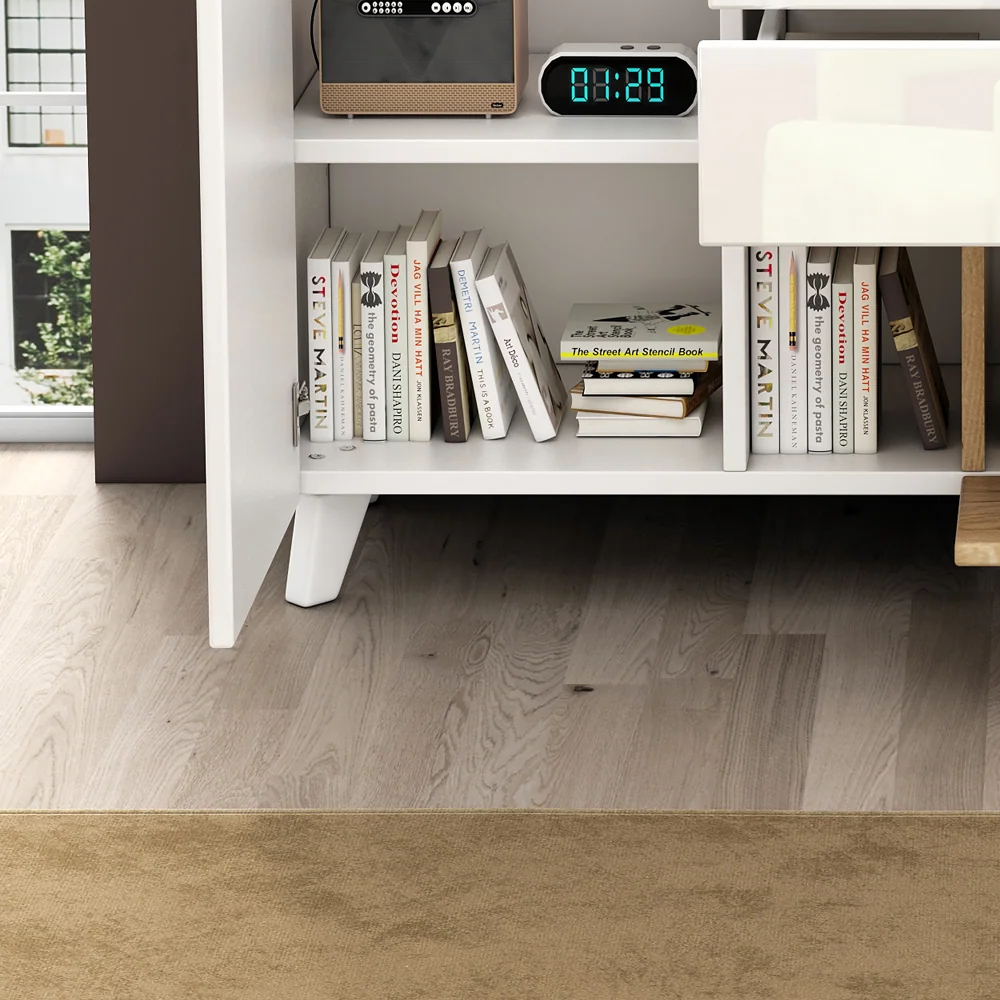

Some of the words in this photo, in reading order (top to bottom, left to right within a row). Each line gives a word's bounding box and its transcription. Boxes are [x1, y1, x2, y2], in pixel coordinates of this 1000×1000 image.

[571, 68, 664, 102] 01:29
[413, 260, 422, 280] JAG
[390, 264, 401, 344] Devotion
[414, 283, 422, 306] VILL
[756, 251, 773, 329] STEVE
[861, 281, 870, 300] JAG
[311, 276, 326, 340] STEVE
[368, 312, 376, 329] the
[414, 310, 422, 324] HA
[862, 304, 870, 325] VILL
[415, 328, 423, 347] MIN
[814, 316, 823, 334] the
[838, 292, 848, 364] Devotion
[862, 329, 870, 343] HA
[366, 331, 377, 386] geometry
[415, 350, 423, 376] HATT
[441, 348, 453, 373] RAY
[458, 269, 473, 313] DEMETRI
[469, 321, 483, 364] MARTIN
[477, 369, 486, 389] THIS
[482, 391, 487, 399] IS
[485, 407, 495, 429] BOOK
[503, 338, 513, 350] Art
[508, 350, 520, 368] Déco
[571, 348, 589, 356] The
[592, 347, 621, 356] Street
[624, 348, 639, 356] Art
[642, 347, 675, 356] Stencil
[678, 348, 703, 356] Book
[862, 346, 870, 364] MIN
[392, 352, 401, 382] DANI
[812, 337, 824, 393] geometry
[862, 367, 870, 393] HATT
[313, 348, 328, 429] MARTIN
[369, 388, 379, 400] of
[756, 339, 773, 437] MARTIN
[839, 372, 848, 397] DANI
[905, 354, 920, 379] RAY
[913, 380, 940, 445] BRADBURY
[367, 402, 377, 433] pasta
[392, 383, 403, 435] SHAPIRO
[445, 375, 459, 438] BRADBURY
[815, 397, 825, 409] of
[813, 411, 824, 443] pasta
[839, 398, 848, 447] SHAPIRO
